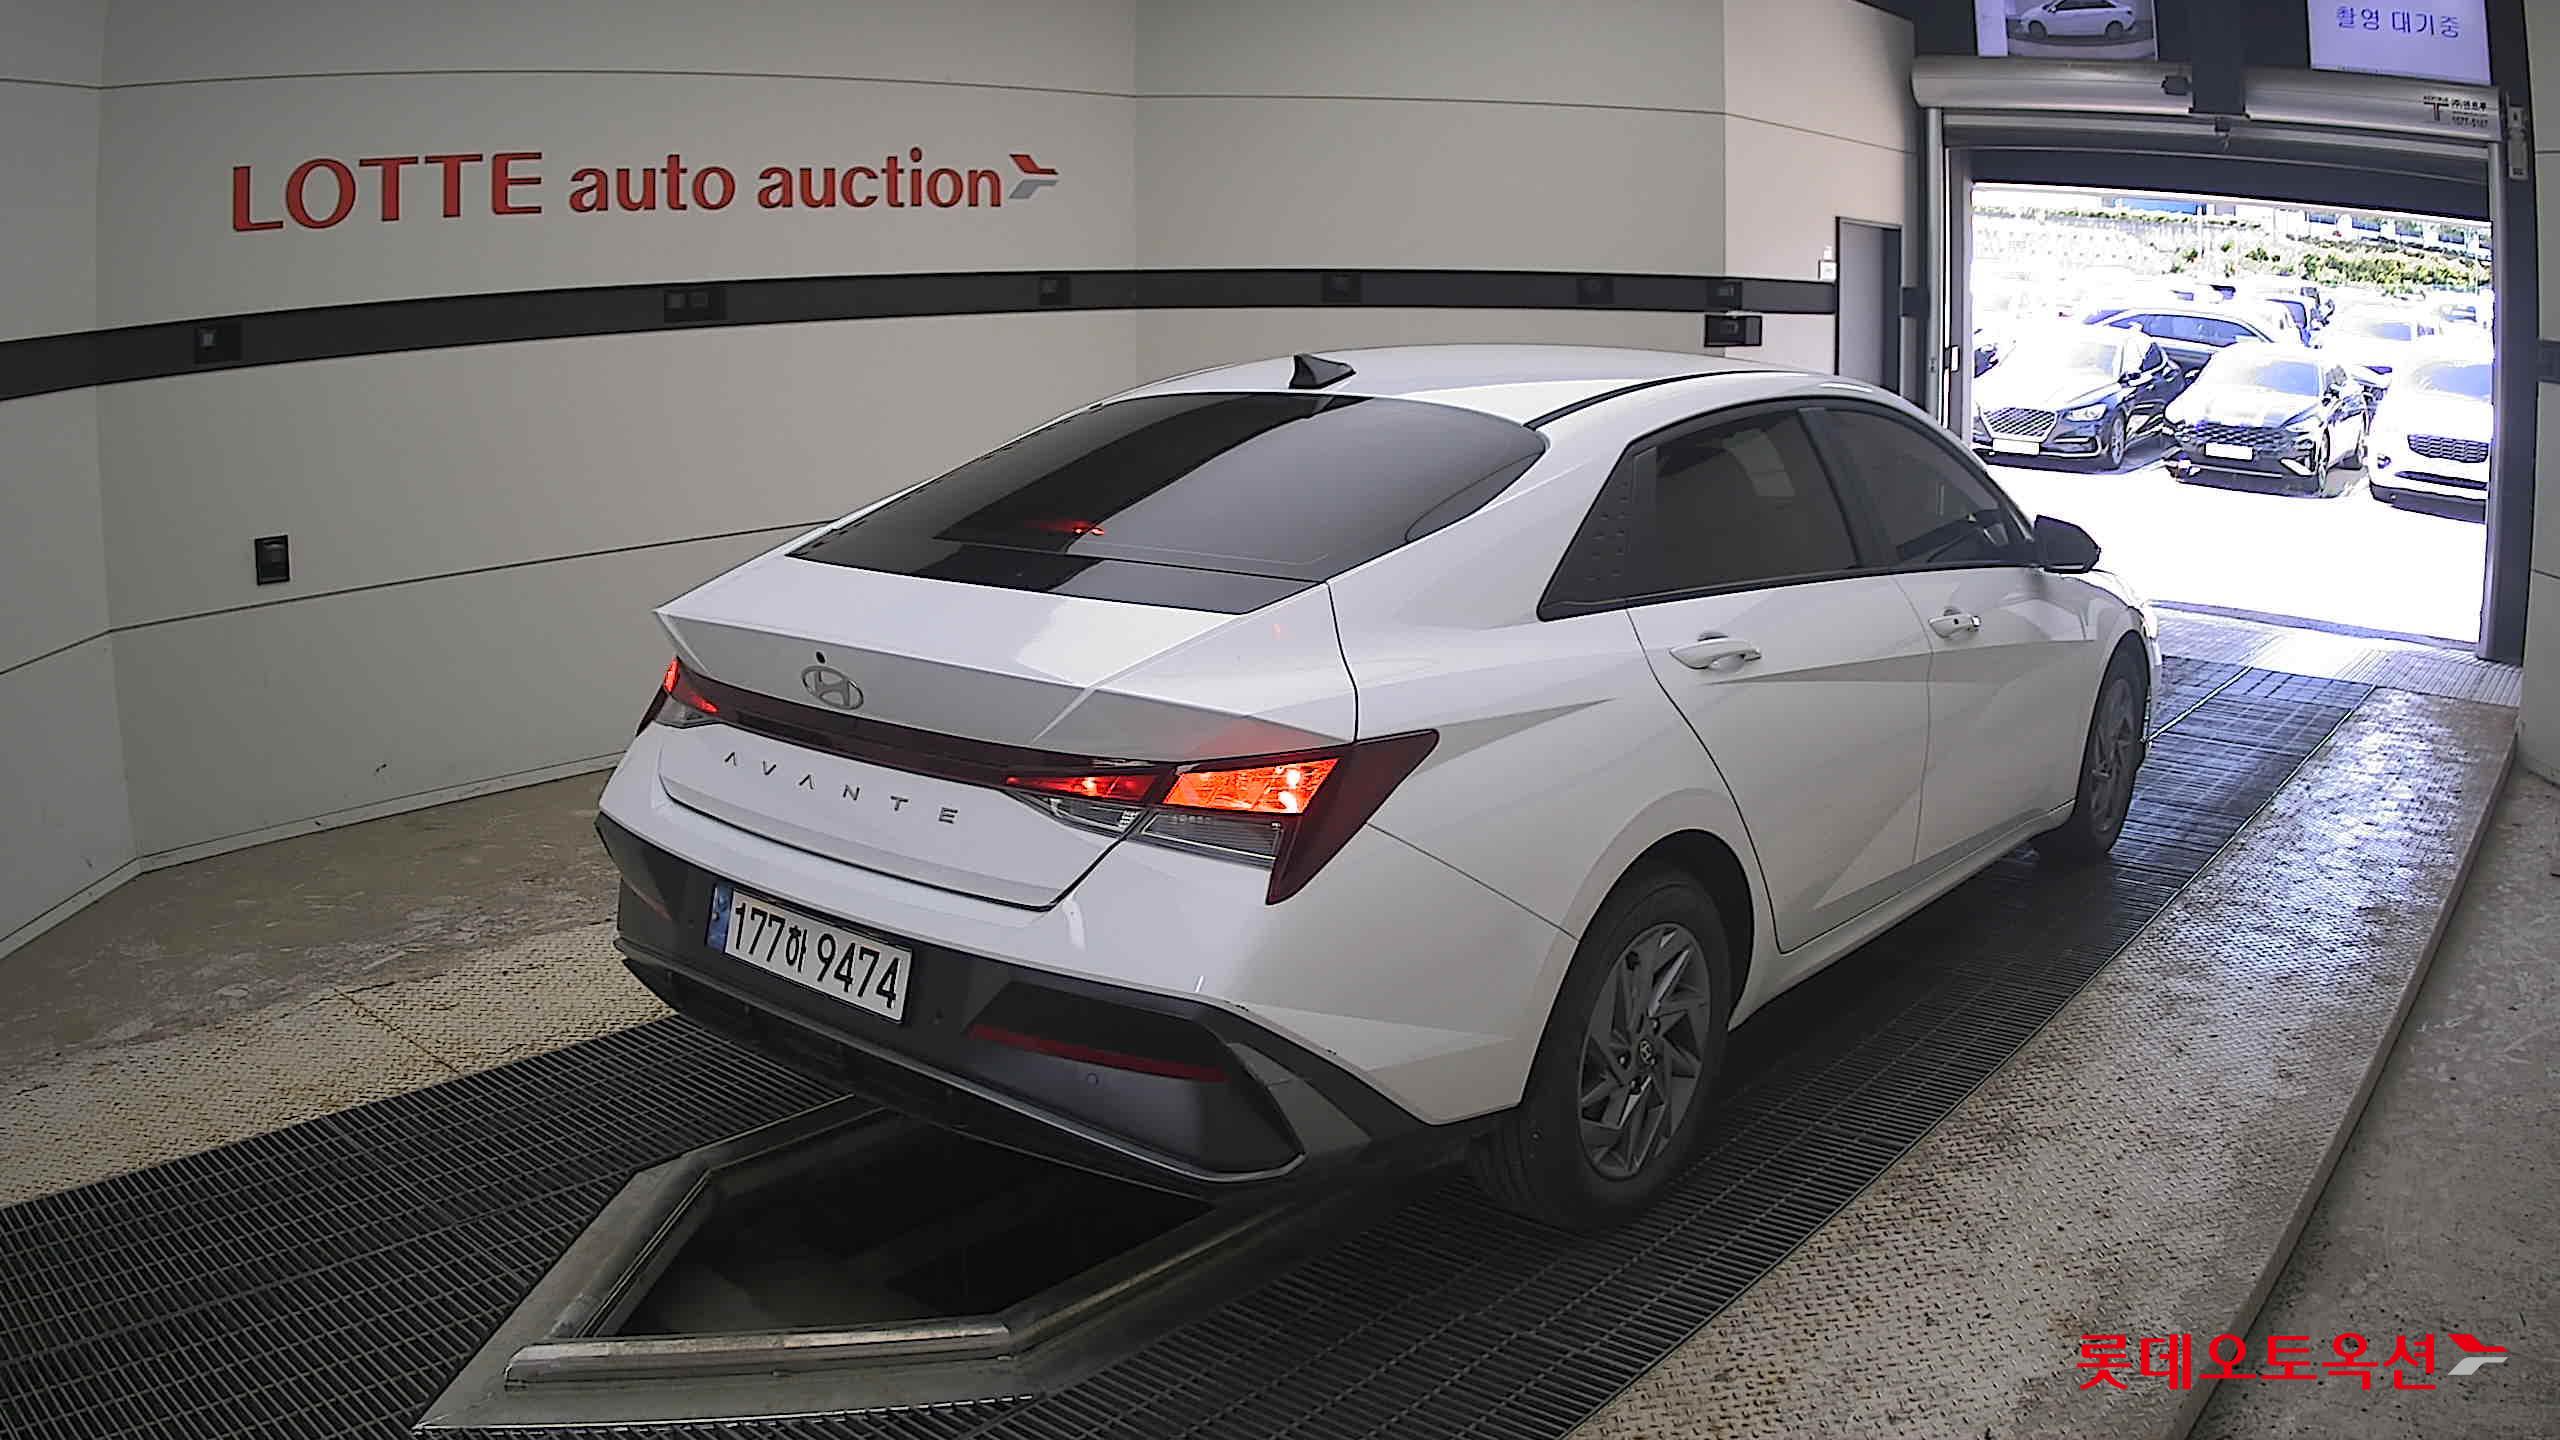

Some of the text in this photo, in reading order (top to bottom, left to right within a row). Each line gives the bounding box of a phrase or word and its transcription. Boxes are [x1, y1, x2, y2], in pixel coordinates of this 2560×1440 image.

[2337, 6, 2459, 39] 촬영 대기중
[233, 146, 1003, 232] LOTTE auto auction
[724, 752, 958, 824] AVANTE
[735, 902, 897, 1009] 177하 9474
